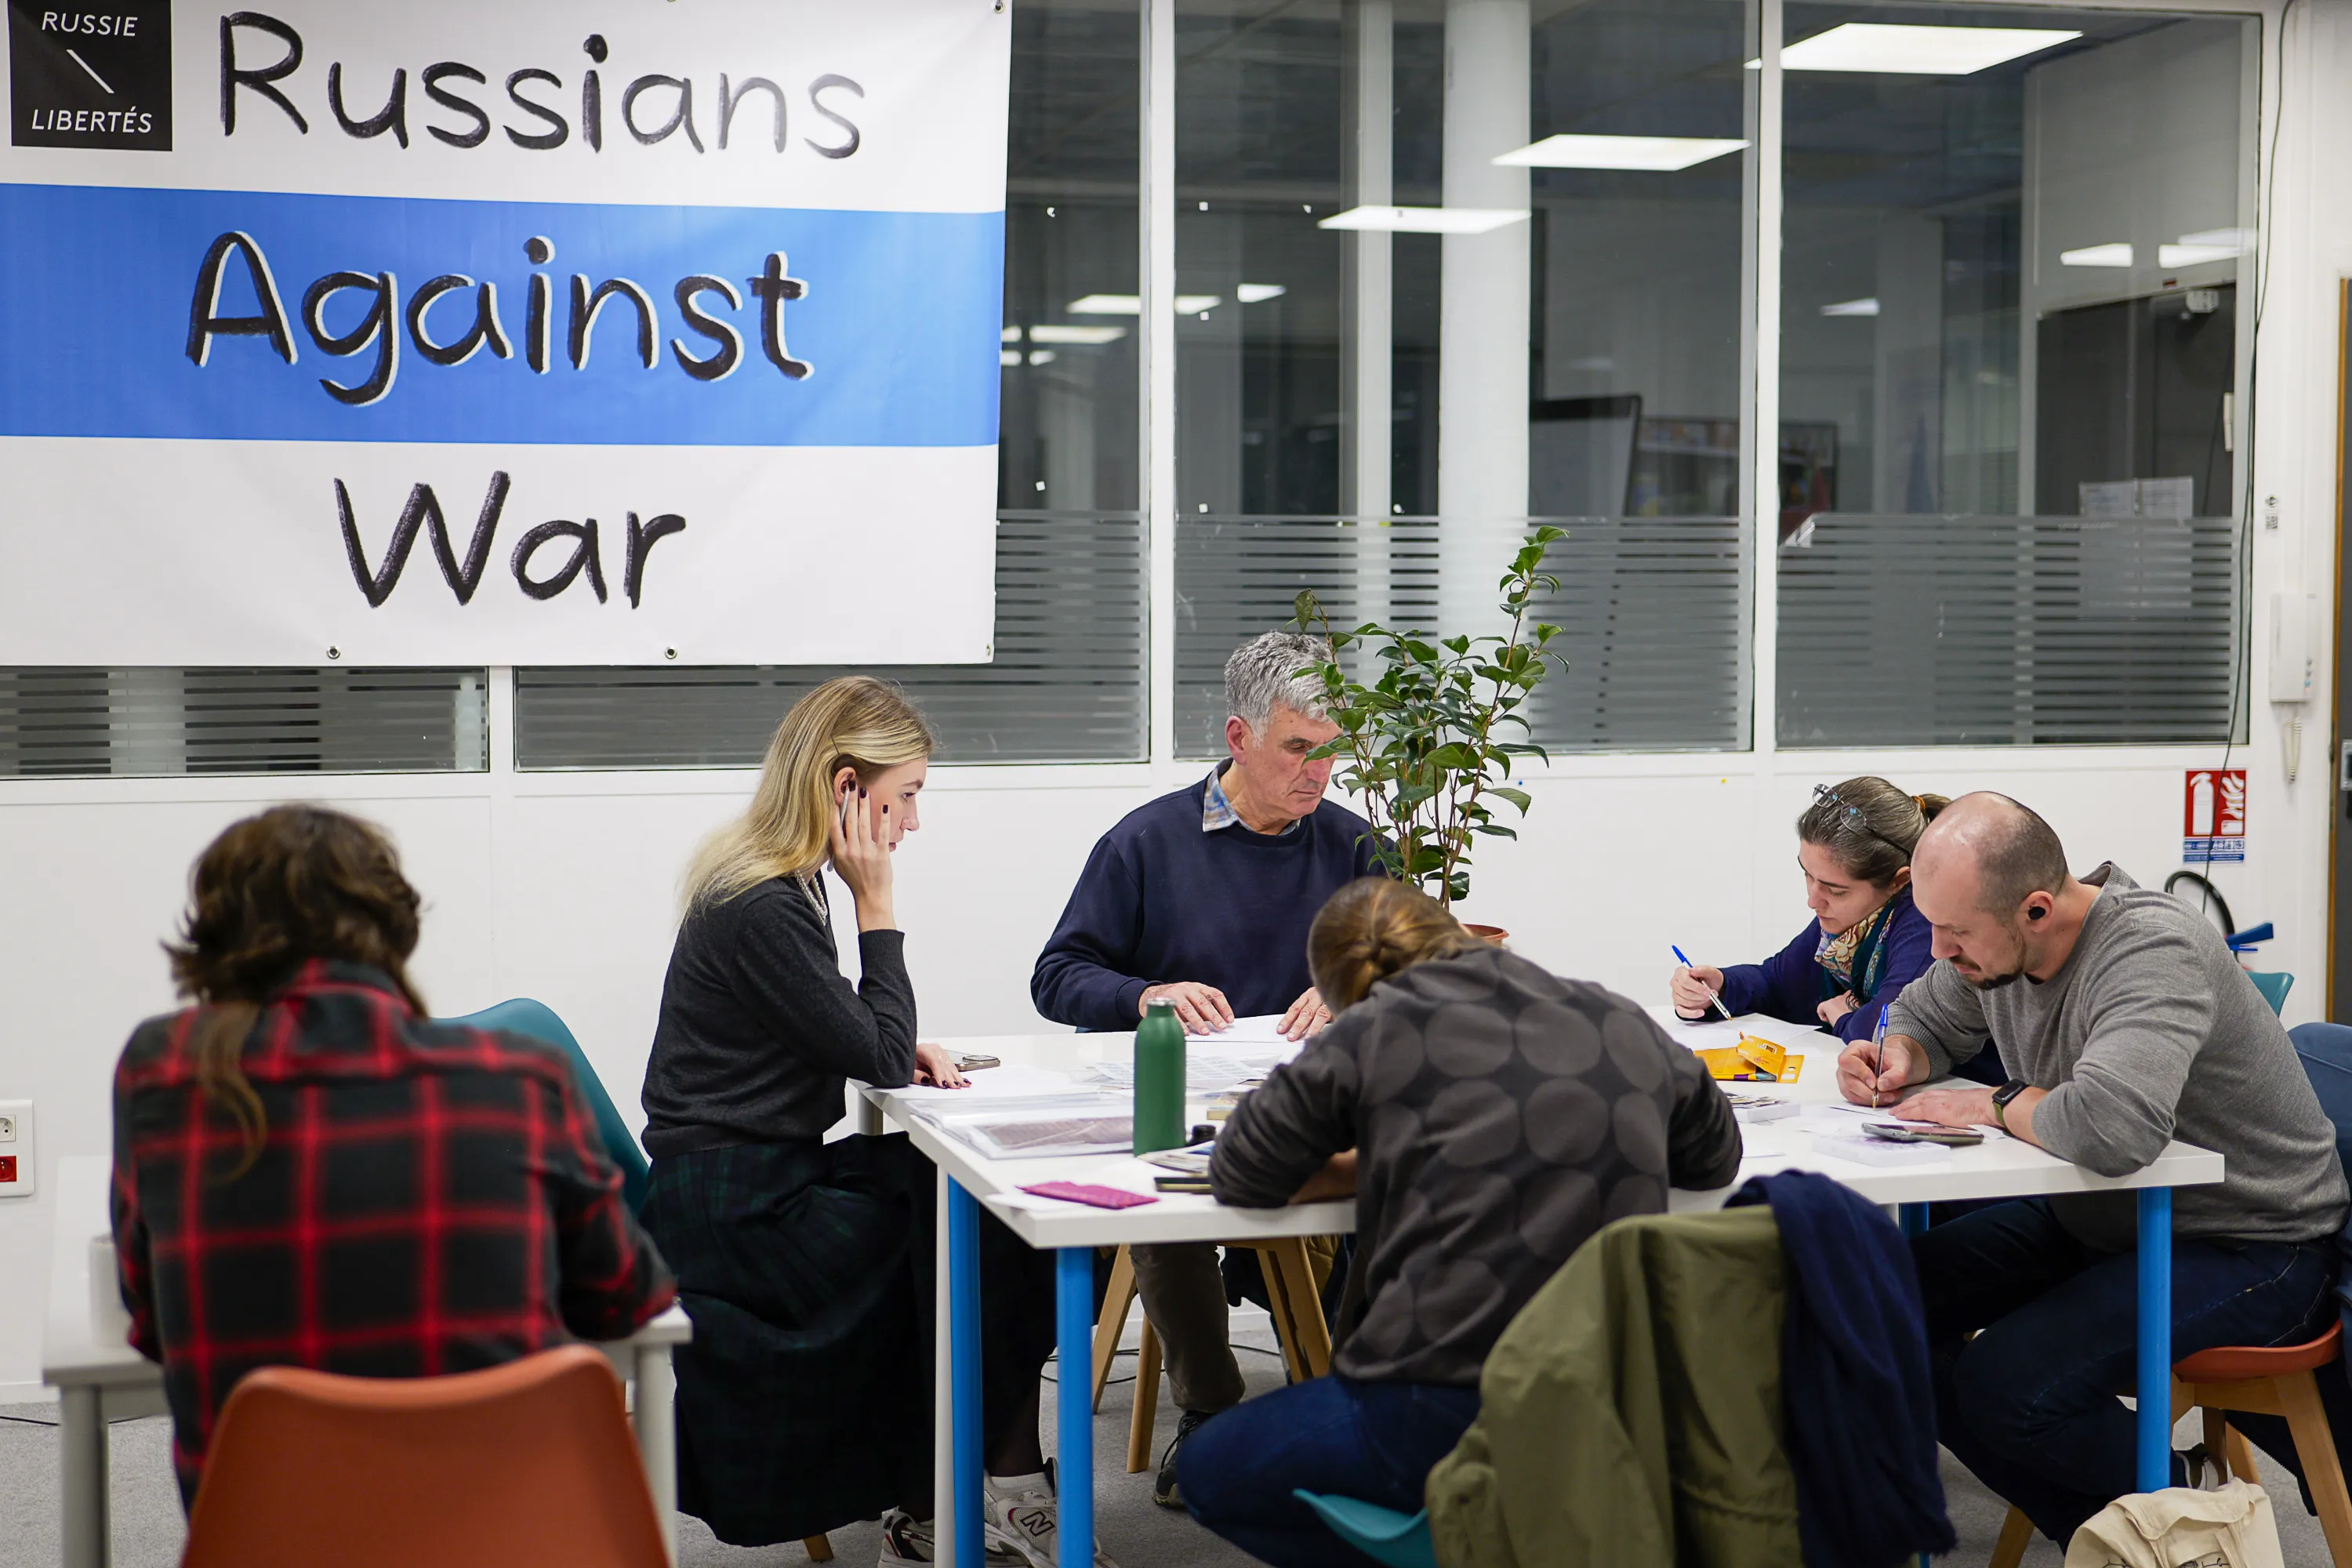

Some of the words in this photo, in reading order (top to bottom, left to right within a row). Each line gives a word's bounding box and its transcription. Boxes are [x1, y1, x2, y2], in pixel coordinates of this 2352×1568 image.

[42, 11, 138, 37] RUSSIE
[31, 106, 152, 133] LIBERTÉS
[220, 10, 866, 160] Russians
[185, 230, 815, 408] Against
[333, 470, 687, 610] War
[1020, 1511, 1055, 1537] N
